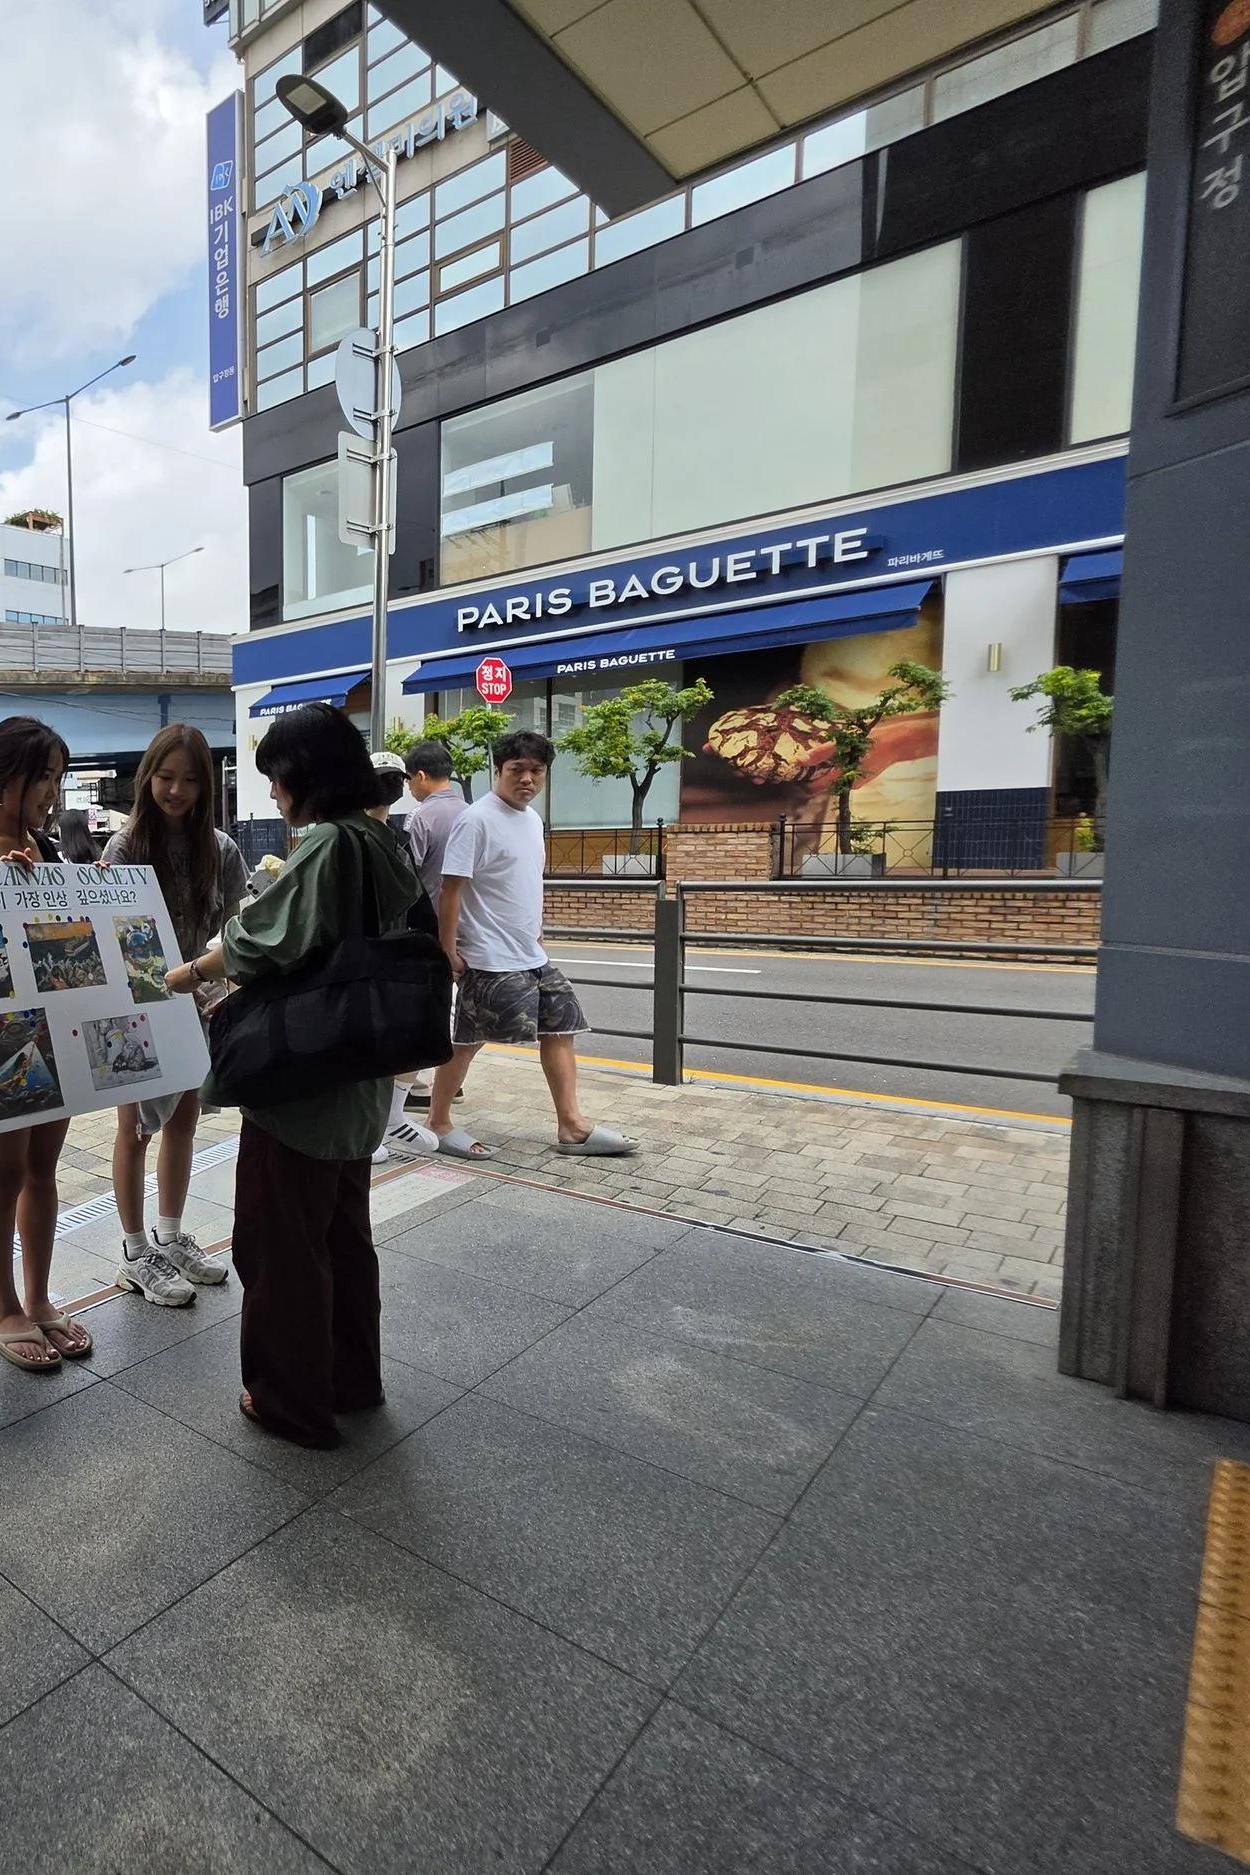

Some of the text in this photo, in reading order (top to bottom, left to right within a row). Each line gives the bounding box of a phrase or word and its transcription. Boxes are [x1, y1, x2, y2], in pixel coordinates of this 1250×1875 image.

[210, 196, 233, 225] IBK
[214, 221, 230, 319] 기업은행
[887, 549, 945, 568] 파리바게뜨
[457, 528, 869, 633] PARIS BAGUETTE
[557, 649, 676, 674] PARIS BAGUETTE
[481, 664, 507, 682] 정지
[481, 683, 507, 695] STOP
[260, 705, 284, 716] PARIS
[76, 867, 148, 887] SOCIETY
[14, 891, 41, 909] 가장
[43, 889, 67, 908] 인상
[76, 889, 137, 906] 깊으셨나요?
